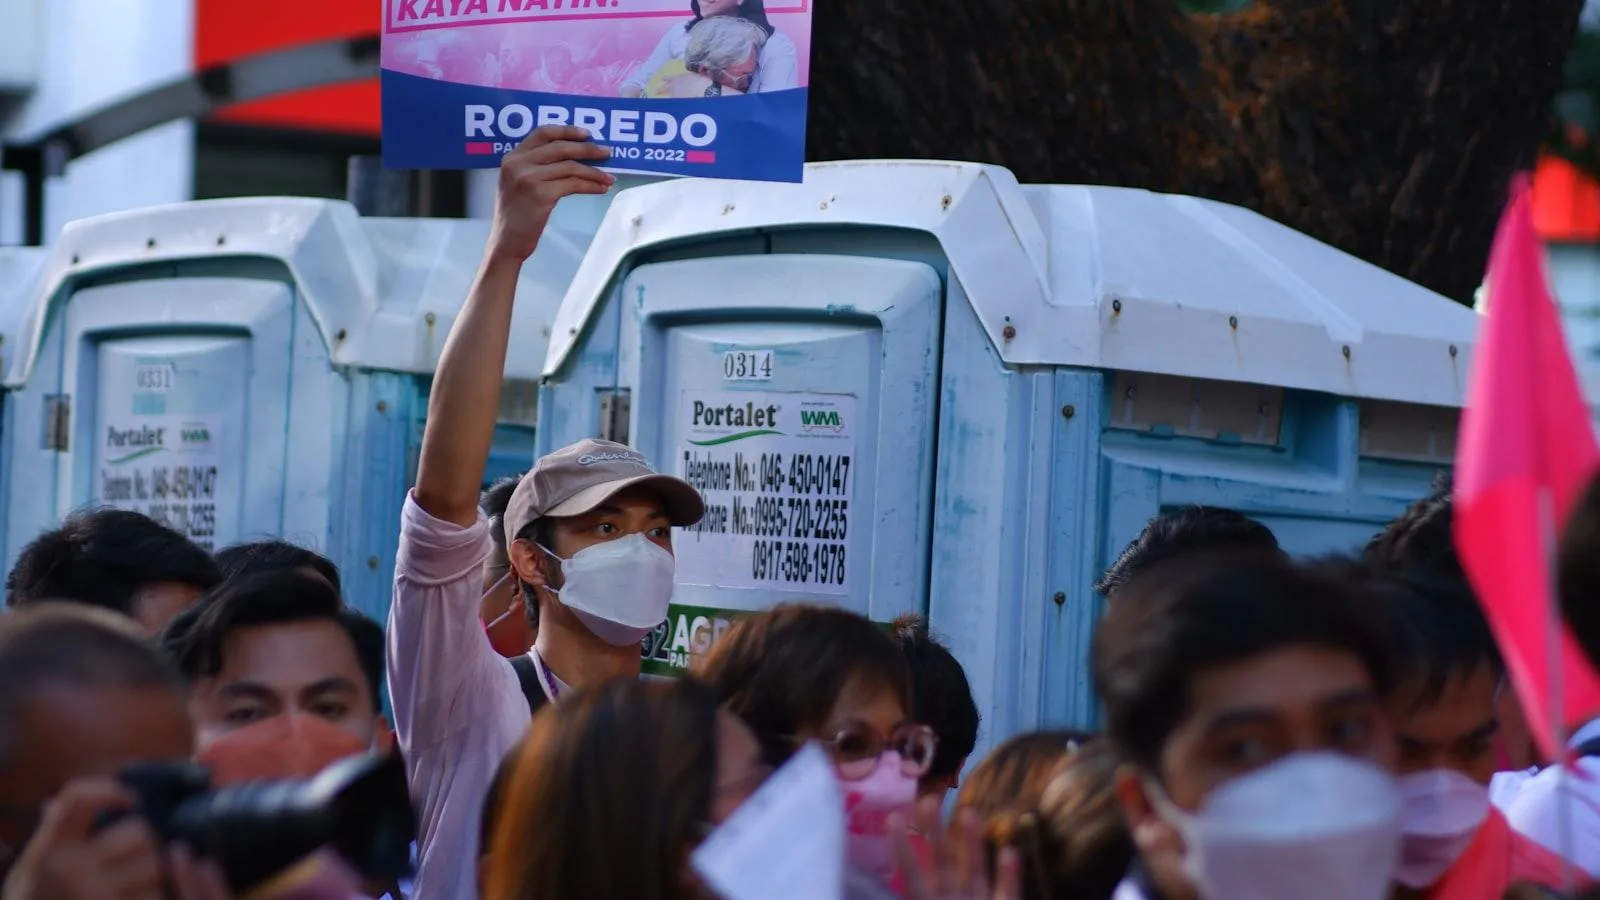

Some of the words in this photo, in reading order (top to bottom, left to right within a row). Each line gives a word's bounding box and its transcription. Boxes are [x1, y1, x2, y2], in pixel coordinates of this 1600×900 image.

[464, 104, 717, 147] ROBREDO
[609, 146, 640, 159] INO
[644, 148, 685, 161] 2022
[724, 352, 772, 378] 0314
[692, 401, 777, 427] Portalet
[753, 540, 846, 585] 0917-598-1978
